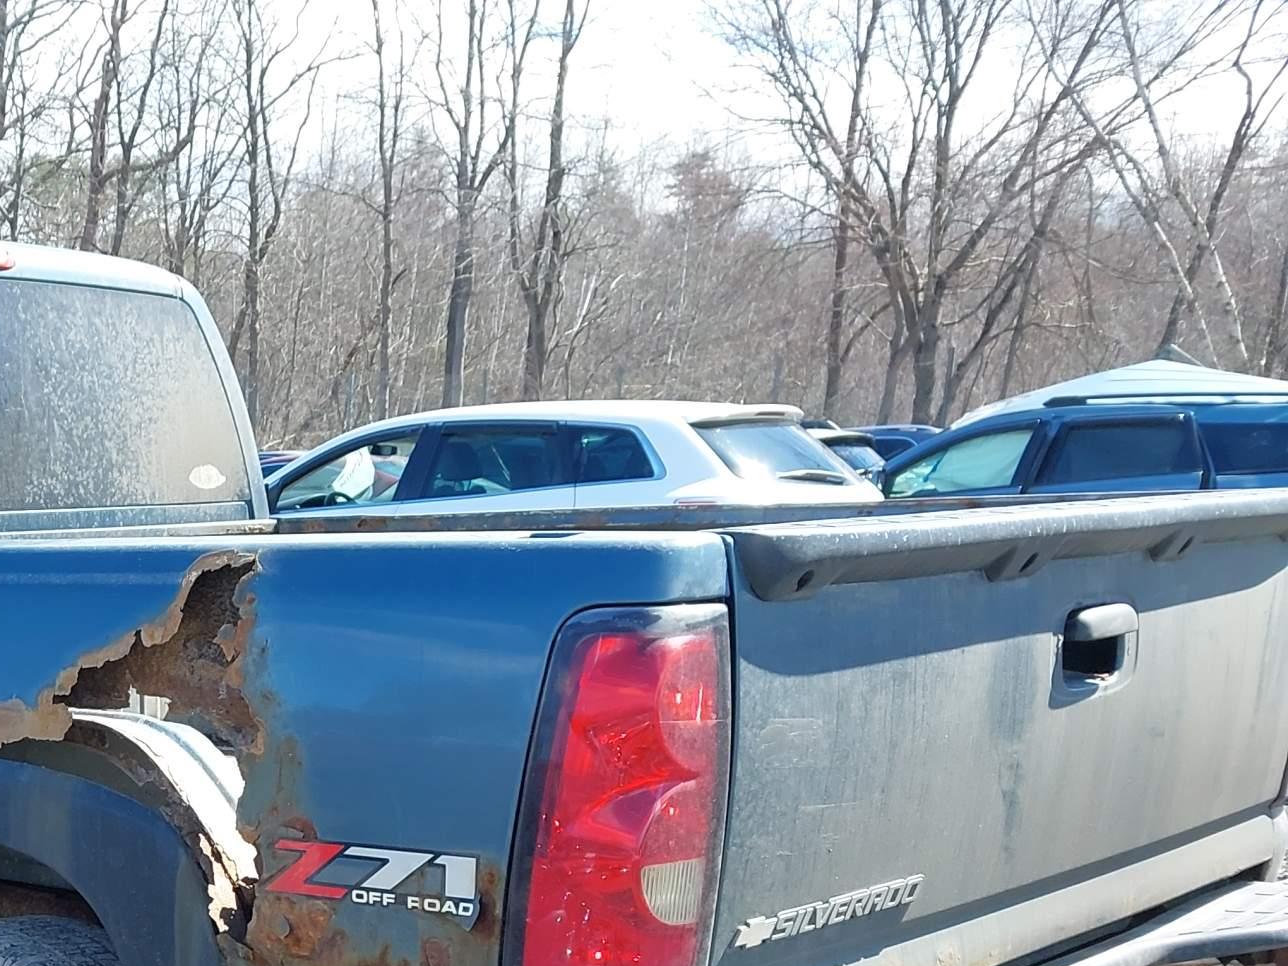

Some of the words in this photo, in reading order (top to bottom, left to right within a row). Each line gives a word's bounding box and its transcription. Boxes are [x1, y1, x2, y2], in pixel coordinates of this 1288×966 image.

[267, 839, 478, 900] Z71
[351, 889, 396, 905] OFF
[406, 896, 474, 917] ROAD
[771, 873, 926, 940] SILVERADO
